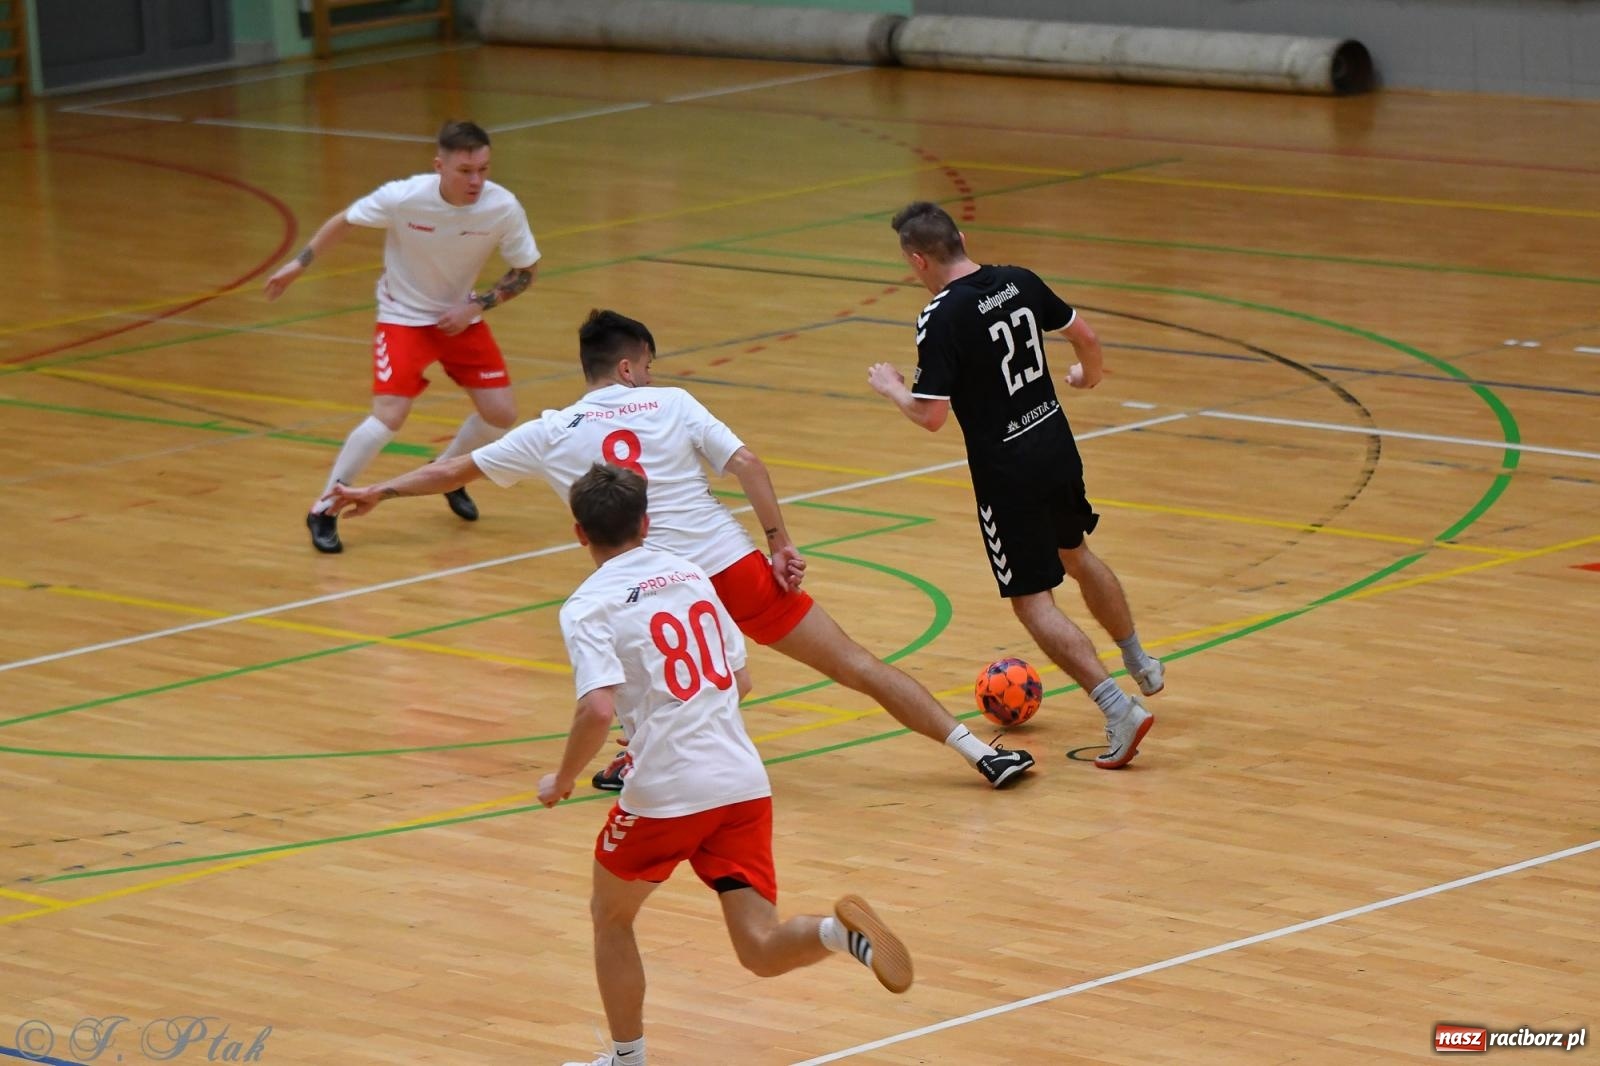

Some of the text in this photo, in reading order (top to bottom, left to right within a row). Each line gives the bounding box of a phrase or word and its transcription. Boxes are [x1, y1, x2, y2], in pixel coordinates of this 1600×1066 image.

[988, 306, 1044, 397] 23
[585, 401, 659, 420] PRD KÜHN
[601, 429, 649, 481] 8
[639, 571, 702, 592] PRD KÜHN
[649, 600, 732, 702] 80
